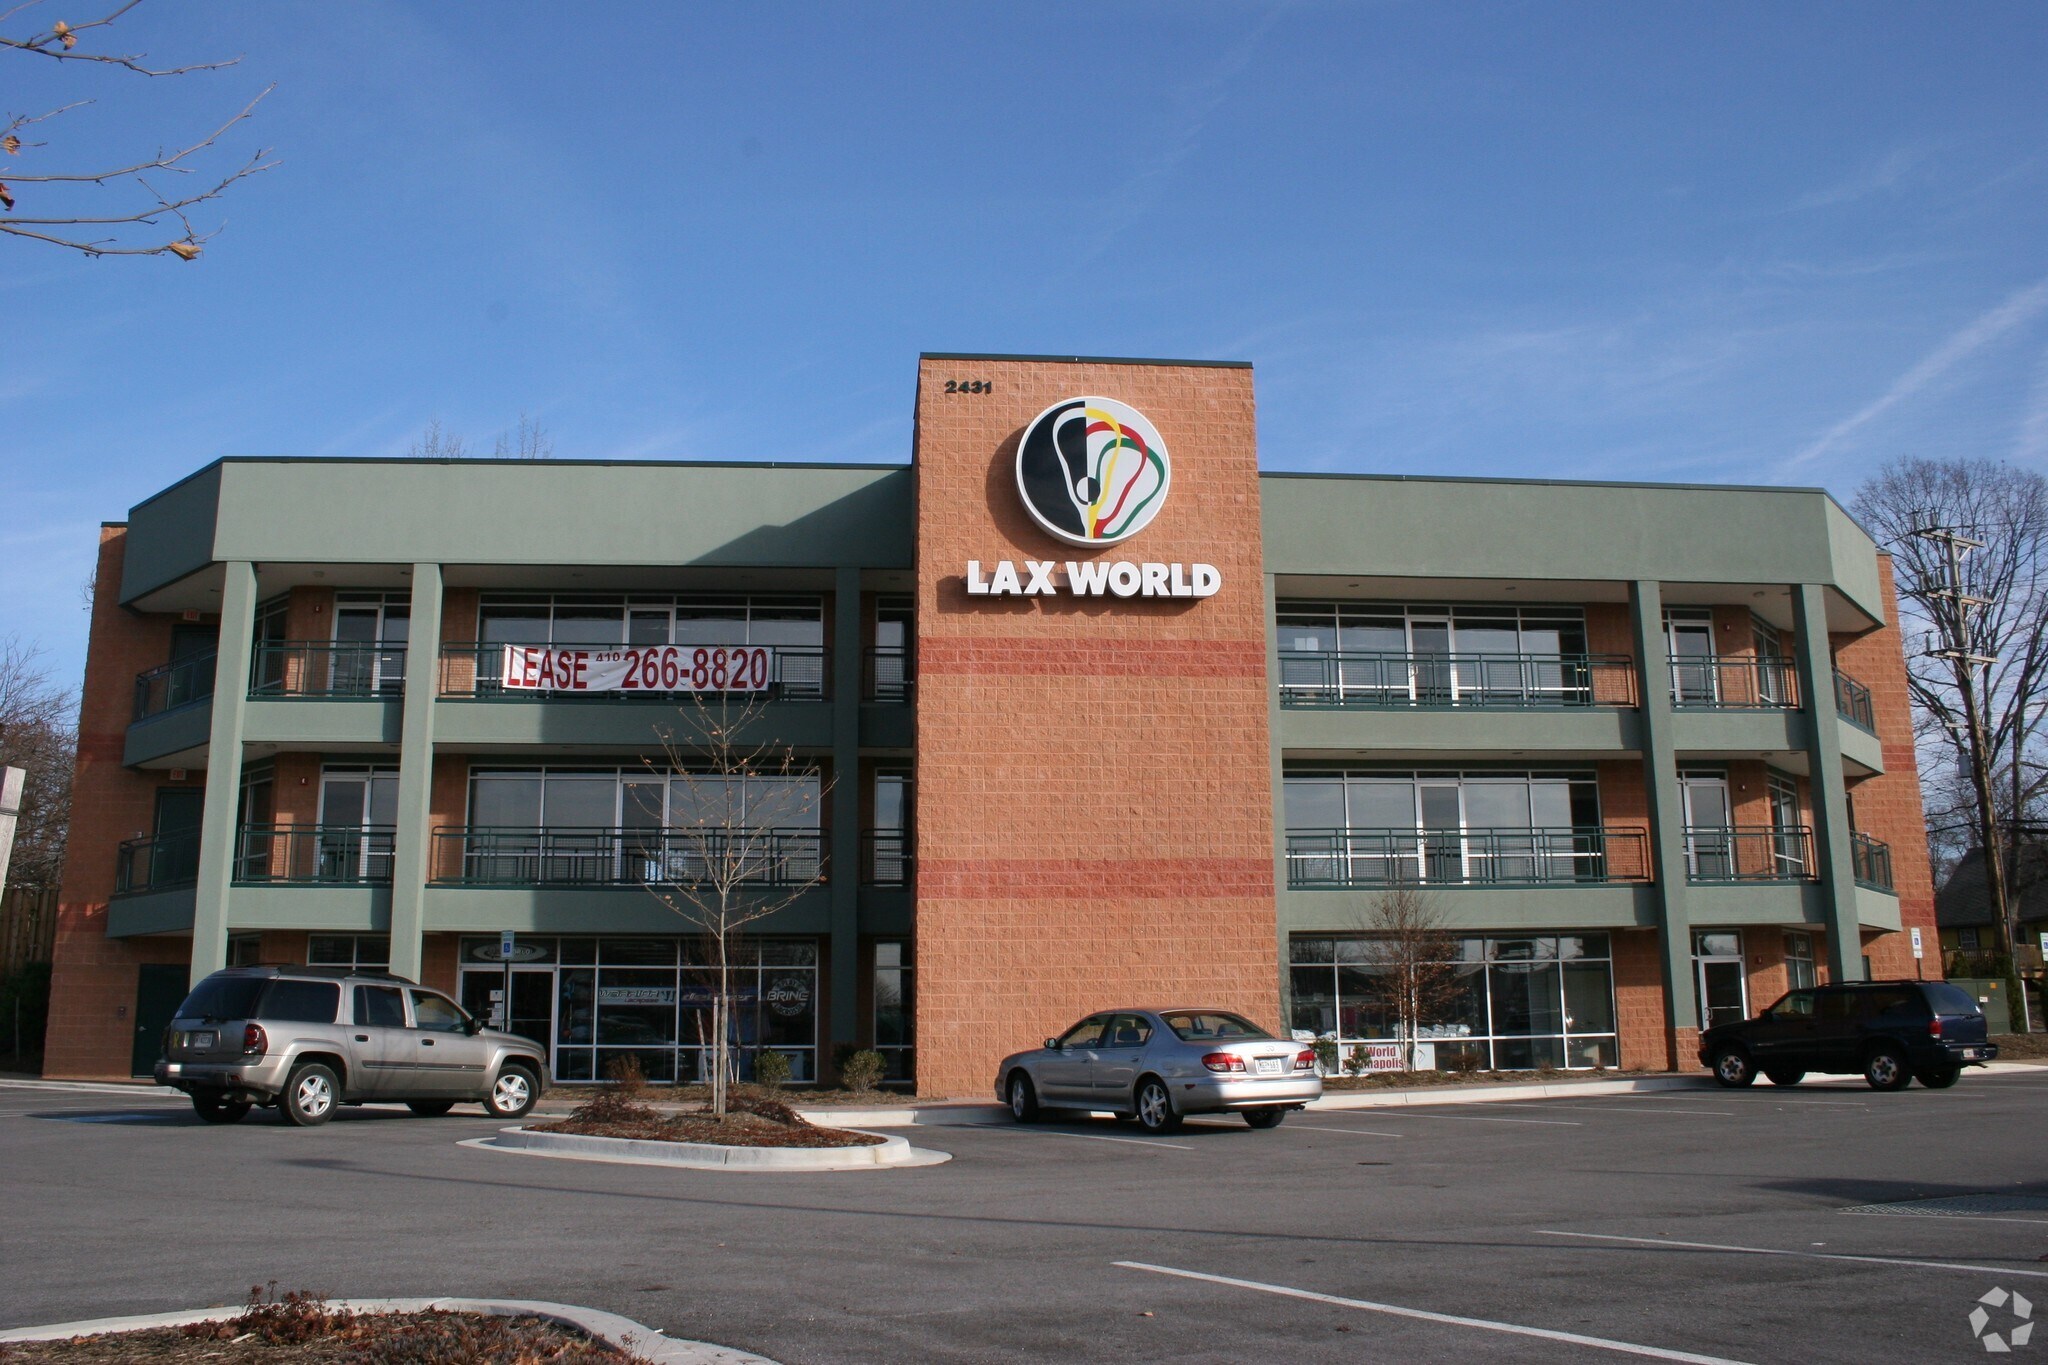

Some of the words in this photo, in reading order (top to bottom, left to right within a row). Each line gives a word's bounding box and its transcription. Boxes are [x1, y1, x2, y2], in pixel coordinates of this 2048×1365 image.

[945, 380, 992, 394] 2431
[967, 560, 1056, 596] LAX
[1065, 561, 1222, 598] WORLD
[507, 646, 588, 689] LEASE
[621, 647, 768, 689] 266-8820
[767, 990, 810, 1001] BRINE
